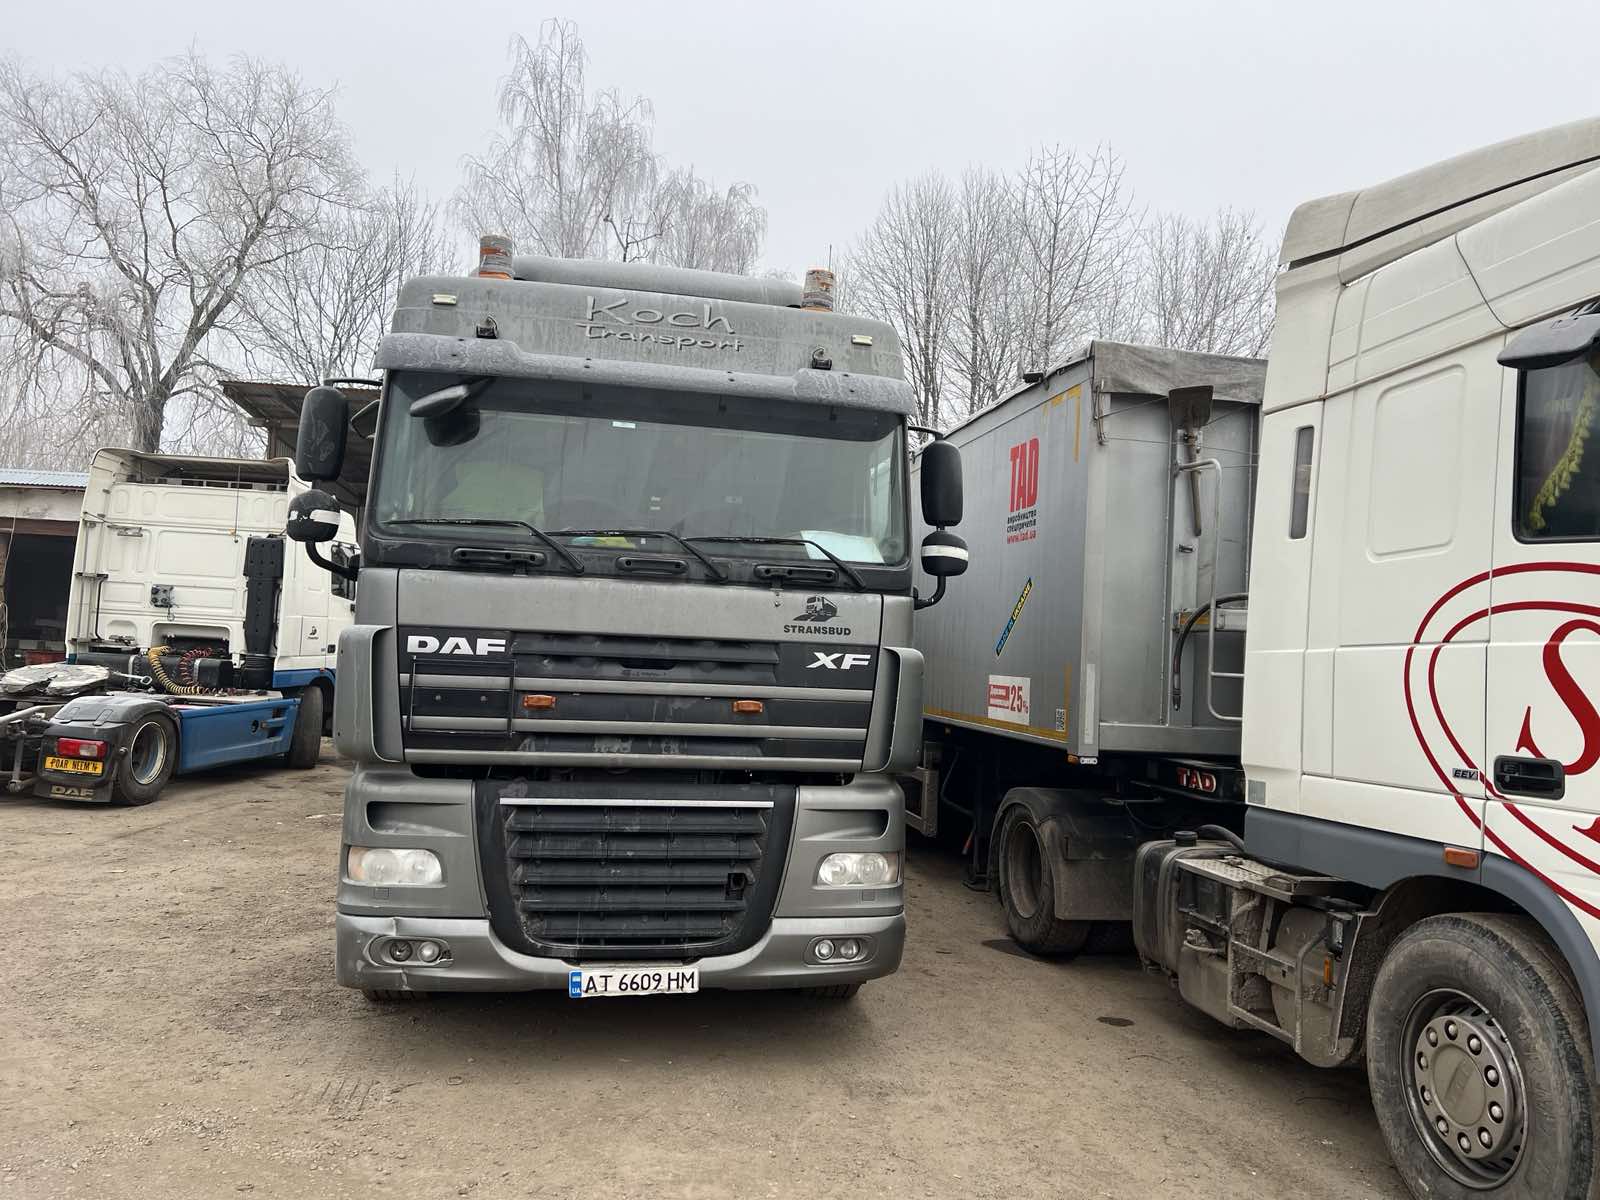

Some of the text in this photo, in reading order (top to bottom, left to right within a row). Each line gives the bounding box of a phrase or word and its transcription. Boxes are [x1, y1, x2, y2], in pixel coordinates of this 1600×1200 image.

[586, 296, 735, 334] Koch
[1009, 438, 1039, 512] TAD
[1011, 581, 1032, 620] UKRAINE
[783, 625, 851, 636] STRANSBUD
[407, 635, 506, 655] DAF
[805, 652, 871, 669] XF
[1177, 767, 1217, 792] TAD
[1454, 769, 1476, 778] EEV
[51, 785, 95, 797] DAF
[584, 971, 695, 993] AT 6609 HM
